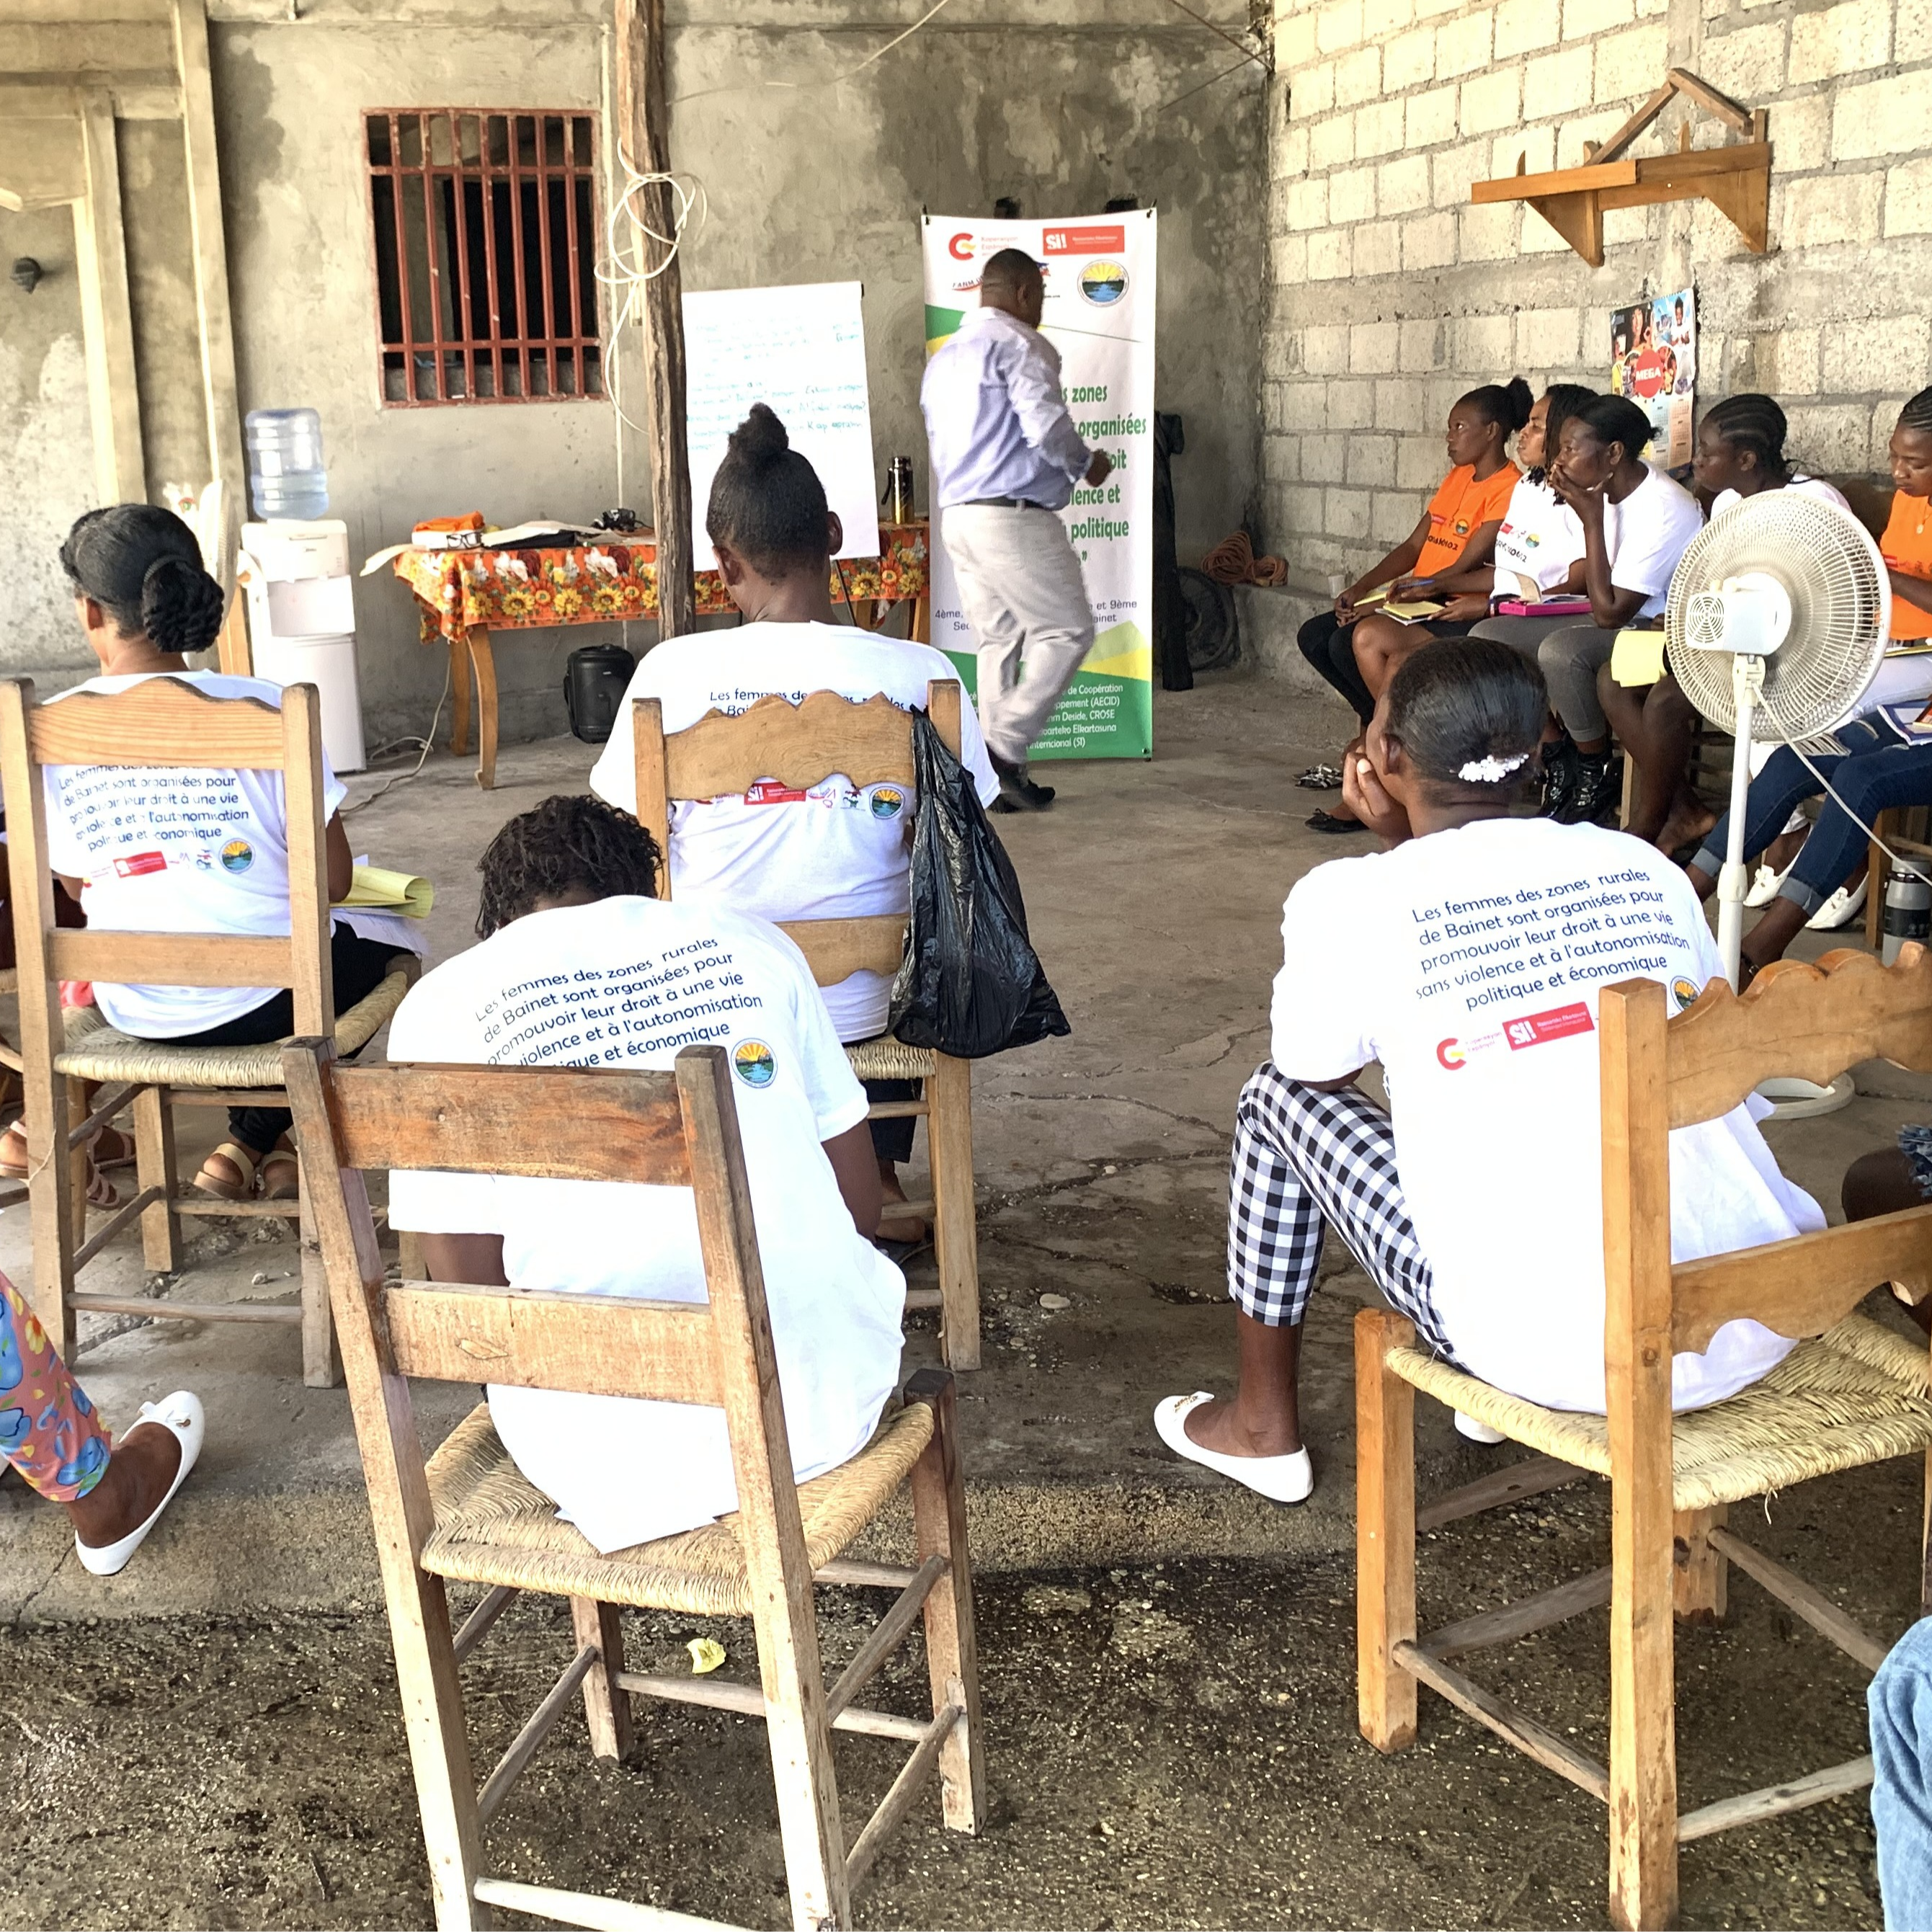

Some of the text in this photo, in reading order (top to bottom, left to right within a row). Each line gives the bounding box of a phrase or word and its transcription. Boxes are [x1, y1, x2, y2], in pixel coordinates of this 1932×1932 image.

[1635, 367, 1661, 381] MEGA
[1072, 386, 1108, 403] zones
[1078, 412, 1147, 440] organisées
[1110, 448, 1127, 469] oit
[1071, 484, 1121, 505] lence et
[1071, 517, 1129, 543] politique
[1097, 602, 1106, 610] et
[1110, 600, 1137, 609] 9ème
[1093, 614, 1117, 623] ainet
[710, 692, 730, 701] Les
[1067, 685, 1077, 695] de
[1079, 683, 1123, 695] Coopération
[1090, 696, 1120, 708] (AECID)
[1090, 709, 1115, 720] CROSE
[1073, 724, 1116, 734] Elkartasuna
[58, 777, 74, 791] Les
[64, 795, 75, 806] de
[112, 778, 137, 789] sont
[141, 775, 202, 788] organisées
[206, 777, 236, 788] pour
[181, 793, 189, 804] à
[193, 795, 216, 805] une
[220, 793, 239, 803] vie
[1412, 869, 1650, 923] Les femmes des zones rurales
[1419, 891, 1663, 945] de Bainet sont organisées pour
[1420, 910, 1674, 974] promouvoir leur droit à une vie
[1416, 930, 1690, 1000] sans violence et à l'autonomisation
[476, 938, 718, 1022] Les femmes des zones rurales
[1466, 956, 1668, 1012] politique et économique
[484, 953, 733, 1043] de Bainet sont organisées pour
[487, 1011, 577, 1065] promouvoir
[581, 1005, 615, 1020] leur
[621, 994, 662, 1012] droit
[666, 989, 678, 1001] à
[683, 979, 715, 996] une
[719, 972, 744, 987] vie
[586, 1026, 604, 1041] et
[608, 1023, 620, 1036] à
[623, 994, 762, 1033] l'autonomisation
[605, 1045, 623, 1061] et
[627, 1023, 730, 1055] économique
